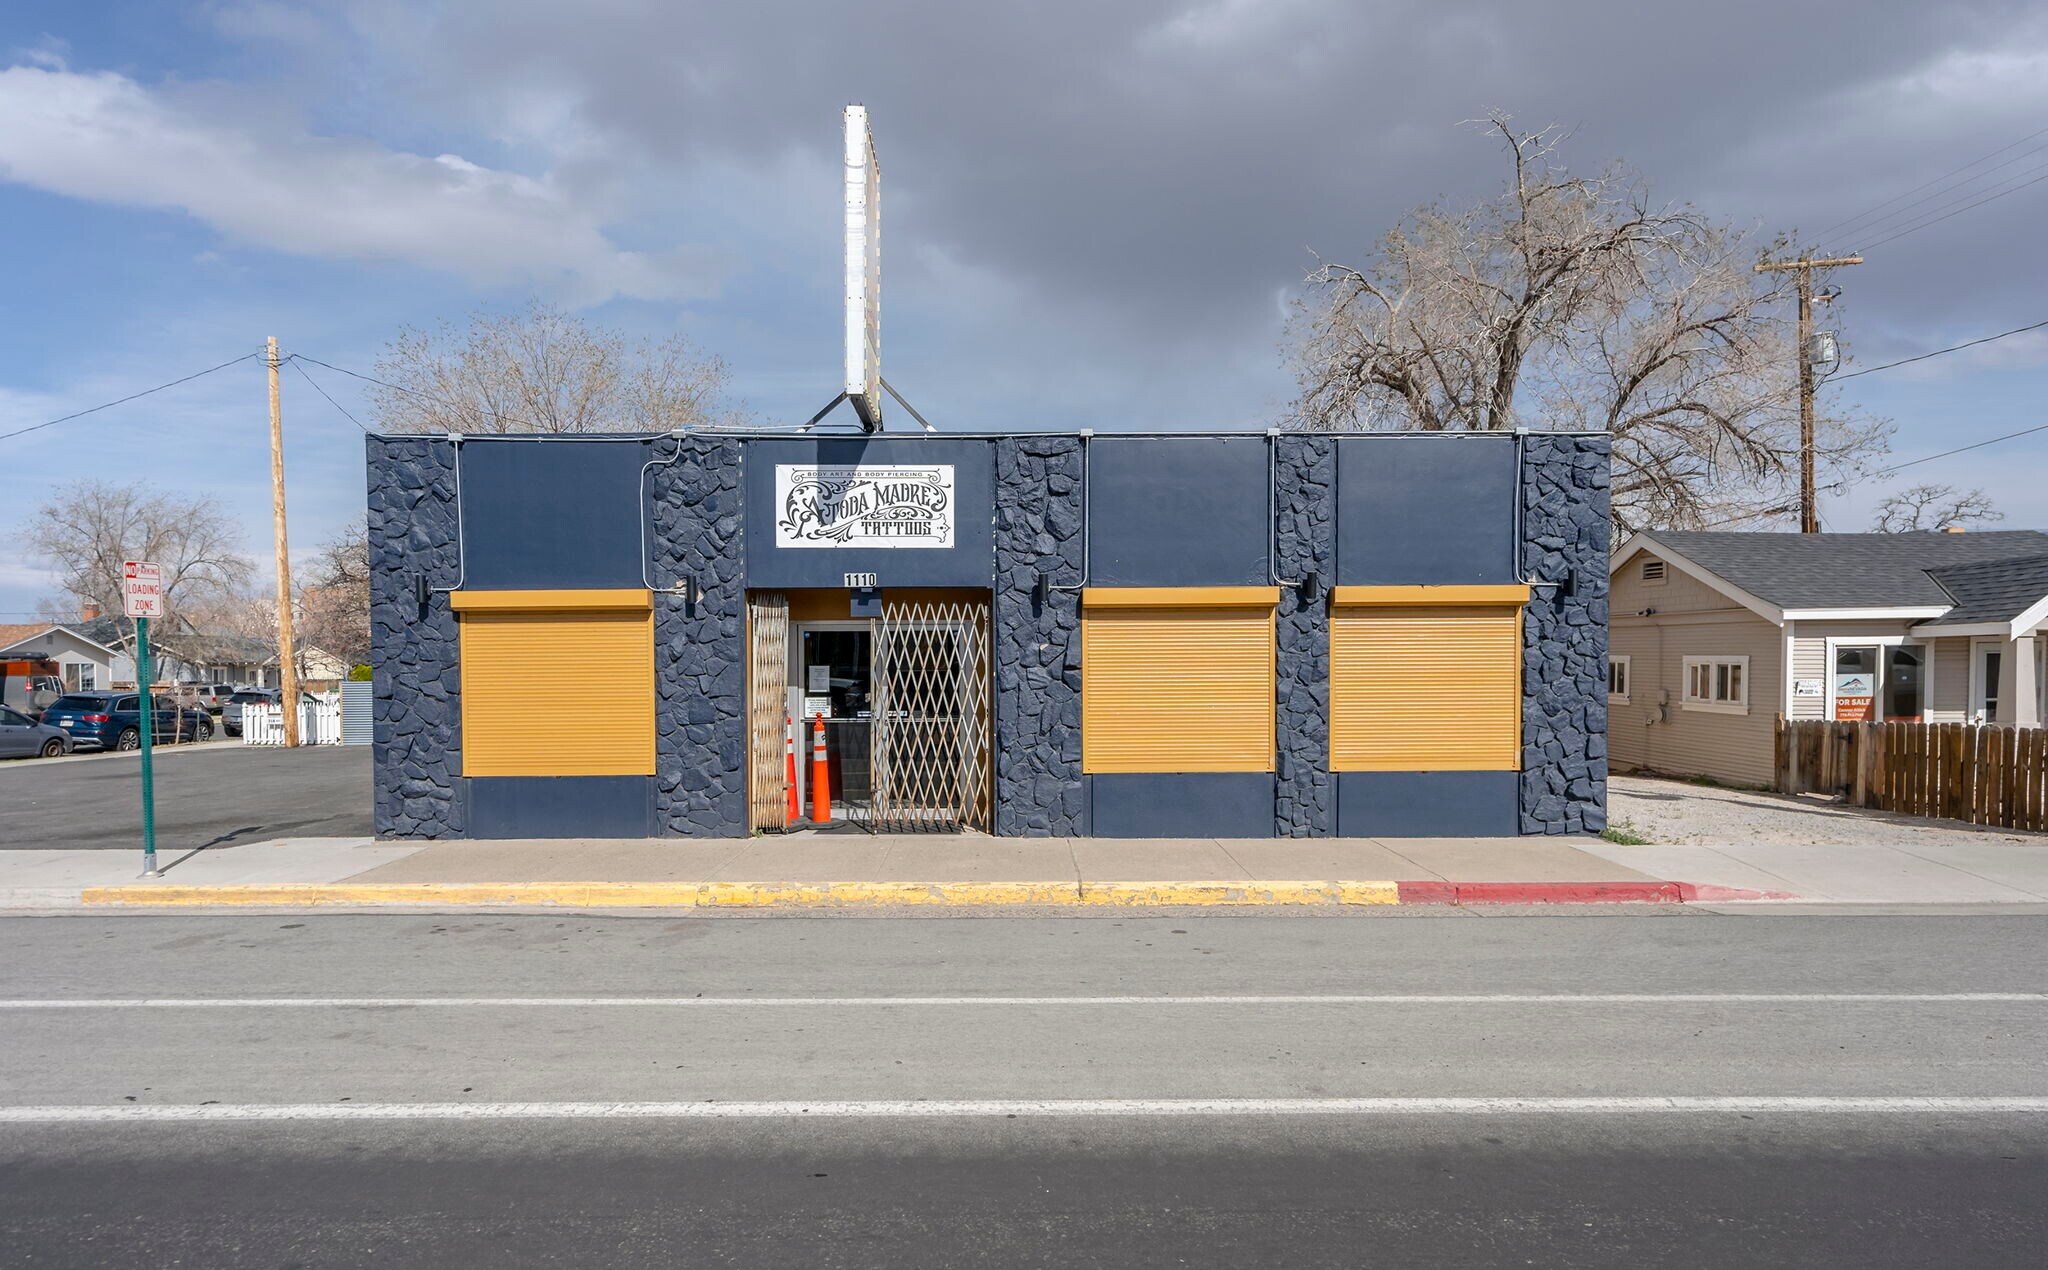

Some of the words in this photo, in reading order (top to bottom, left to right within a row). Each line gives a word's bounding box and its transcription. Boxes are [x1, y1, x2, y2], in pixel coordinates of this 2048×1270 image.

[873, 482, 933, 512] MADRE
[861, 521, 932, 536] TATTOOS
[126, 565, 136, 576] NO
[846, 573, 875, 586] 1110
[128, 584, 159, 595] LOADING
[135, 600, 154, 610] ZONE
[1836, 698, 1850, 706] FOR
[1851, 698, 1871, 706] SALE
